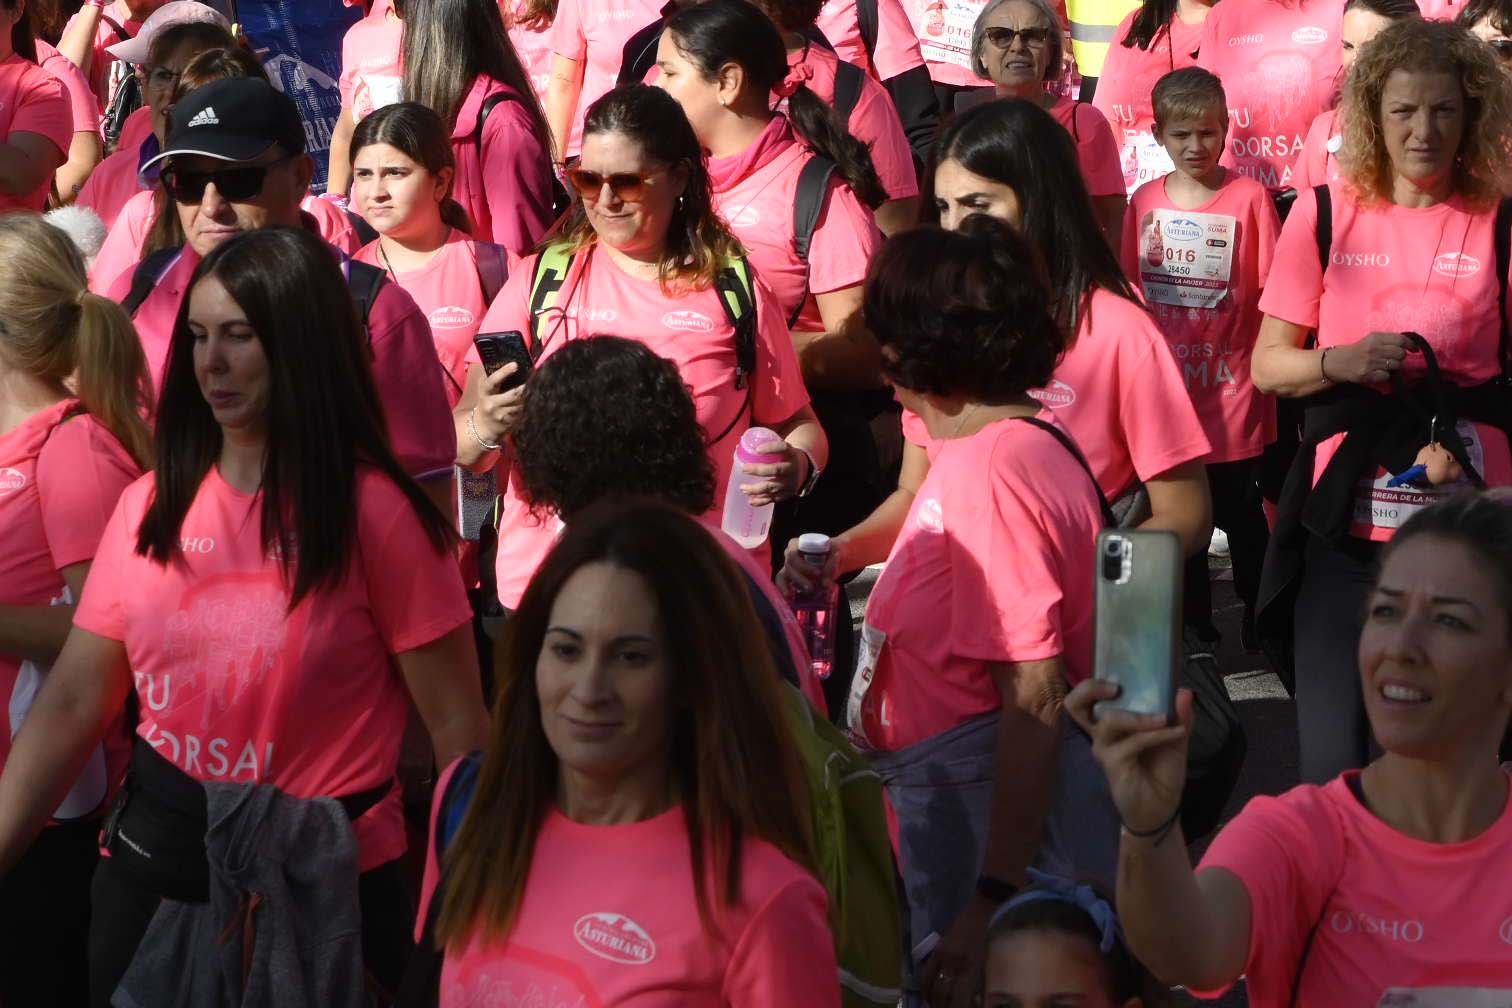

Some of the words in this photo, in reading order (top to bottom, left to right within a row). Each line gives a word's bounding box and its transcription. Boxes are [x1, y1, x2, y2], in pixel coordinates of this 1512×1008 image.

[1229, 32, 1265, 47] OYSHO
[188, 117, 219, 128] adidas
[1228, 107, 1250, 128] TU
[1166, 247, 1196, 262] 016
[1332, 253, 1390, 267] OYSHO
[1373, 507, 1398, 519] SHO
[579, 921, 648, 961] ASTURIANA
